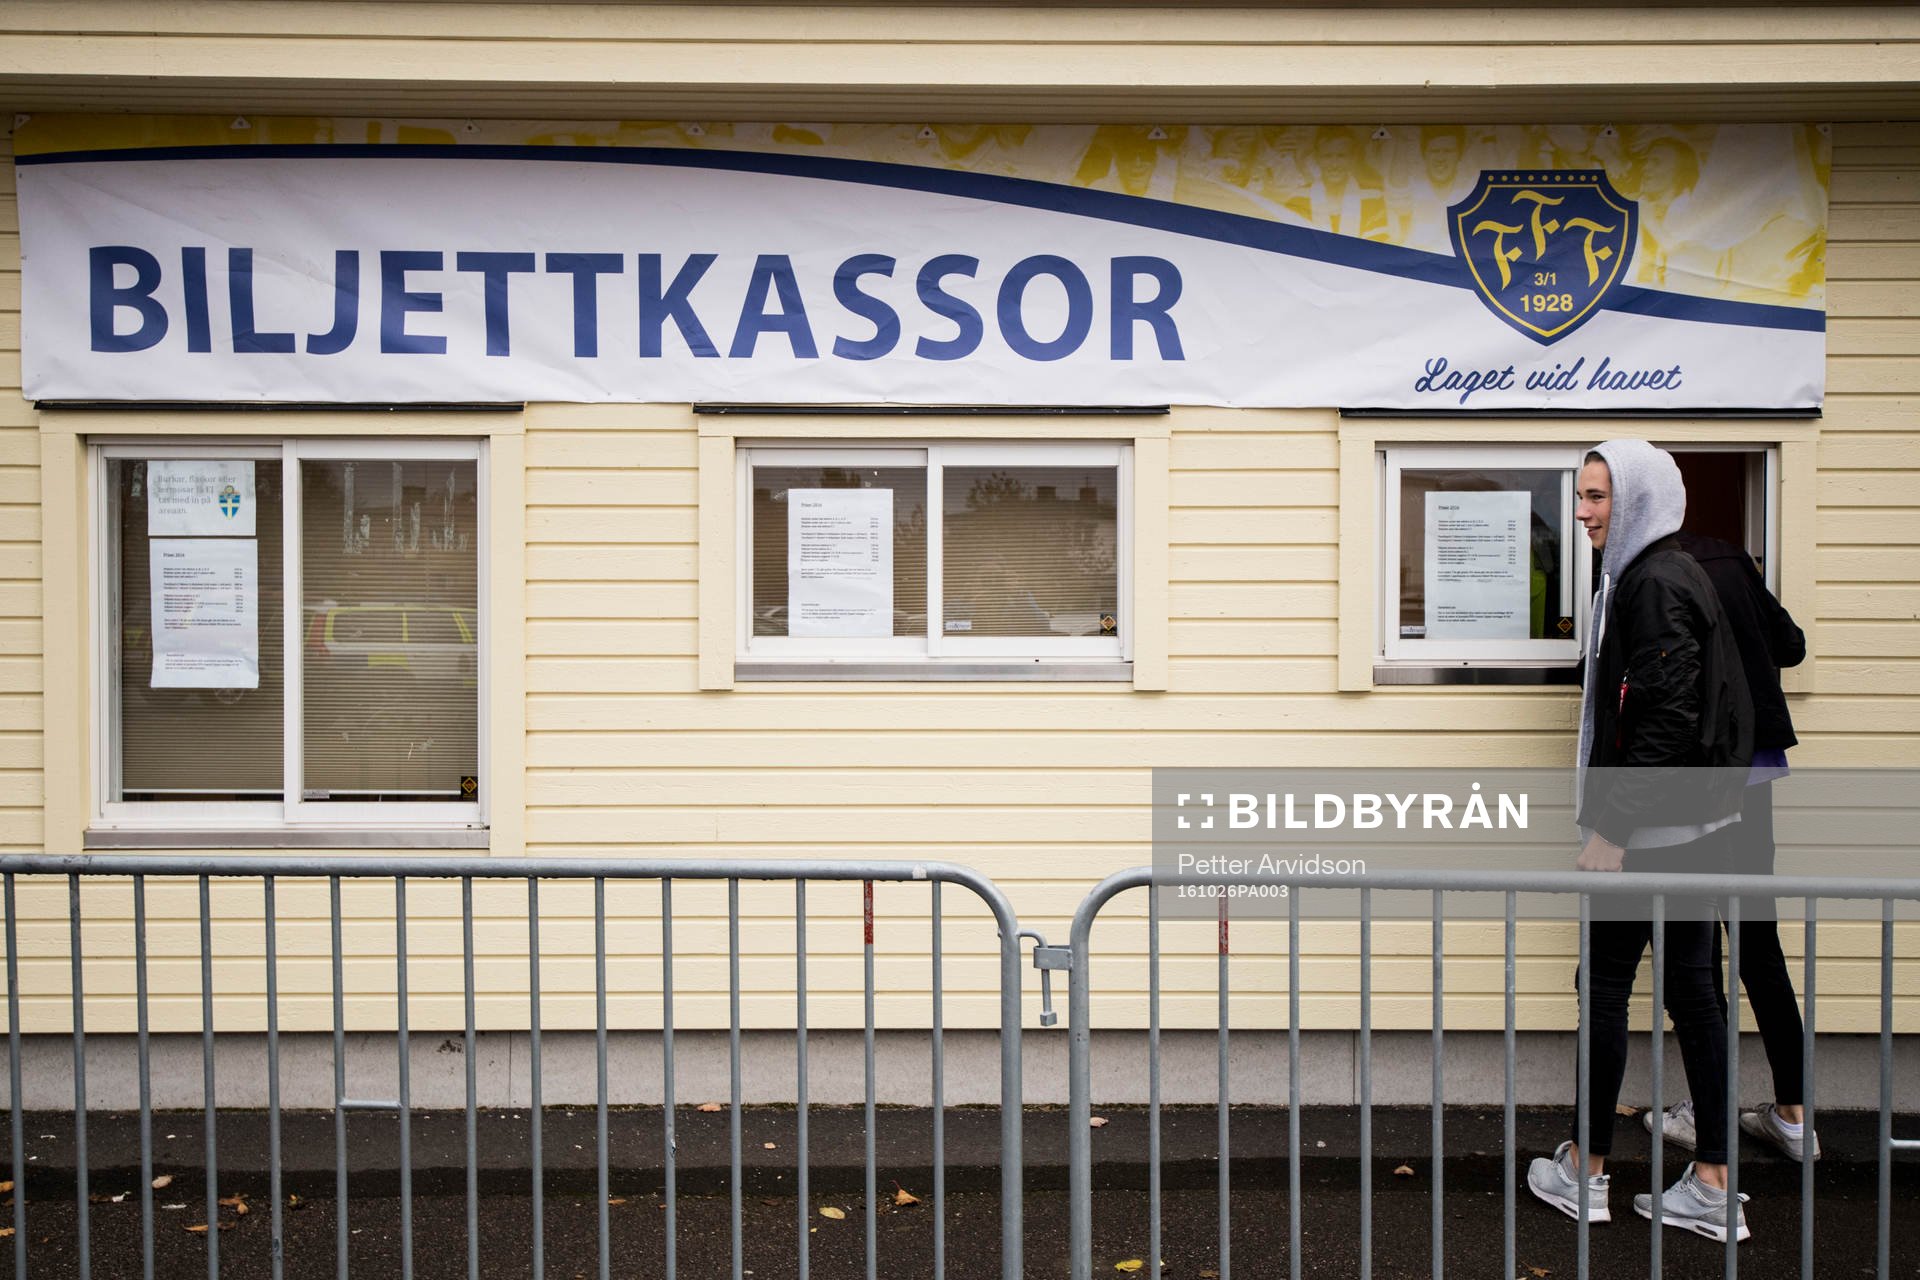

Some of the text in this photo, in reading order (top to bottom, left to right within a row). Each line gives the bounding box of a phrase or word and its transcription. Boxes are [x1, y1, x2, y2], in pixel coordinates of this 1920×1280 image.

[1534, 272, 1557, 286] 3/1
[89, 246, 1186, 361] BILJETTKASSOR
[1520, 294, 1574, 313] 1928
[1415, 357, 1682, 405] Laget vid havet
